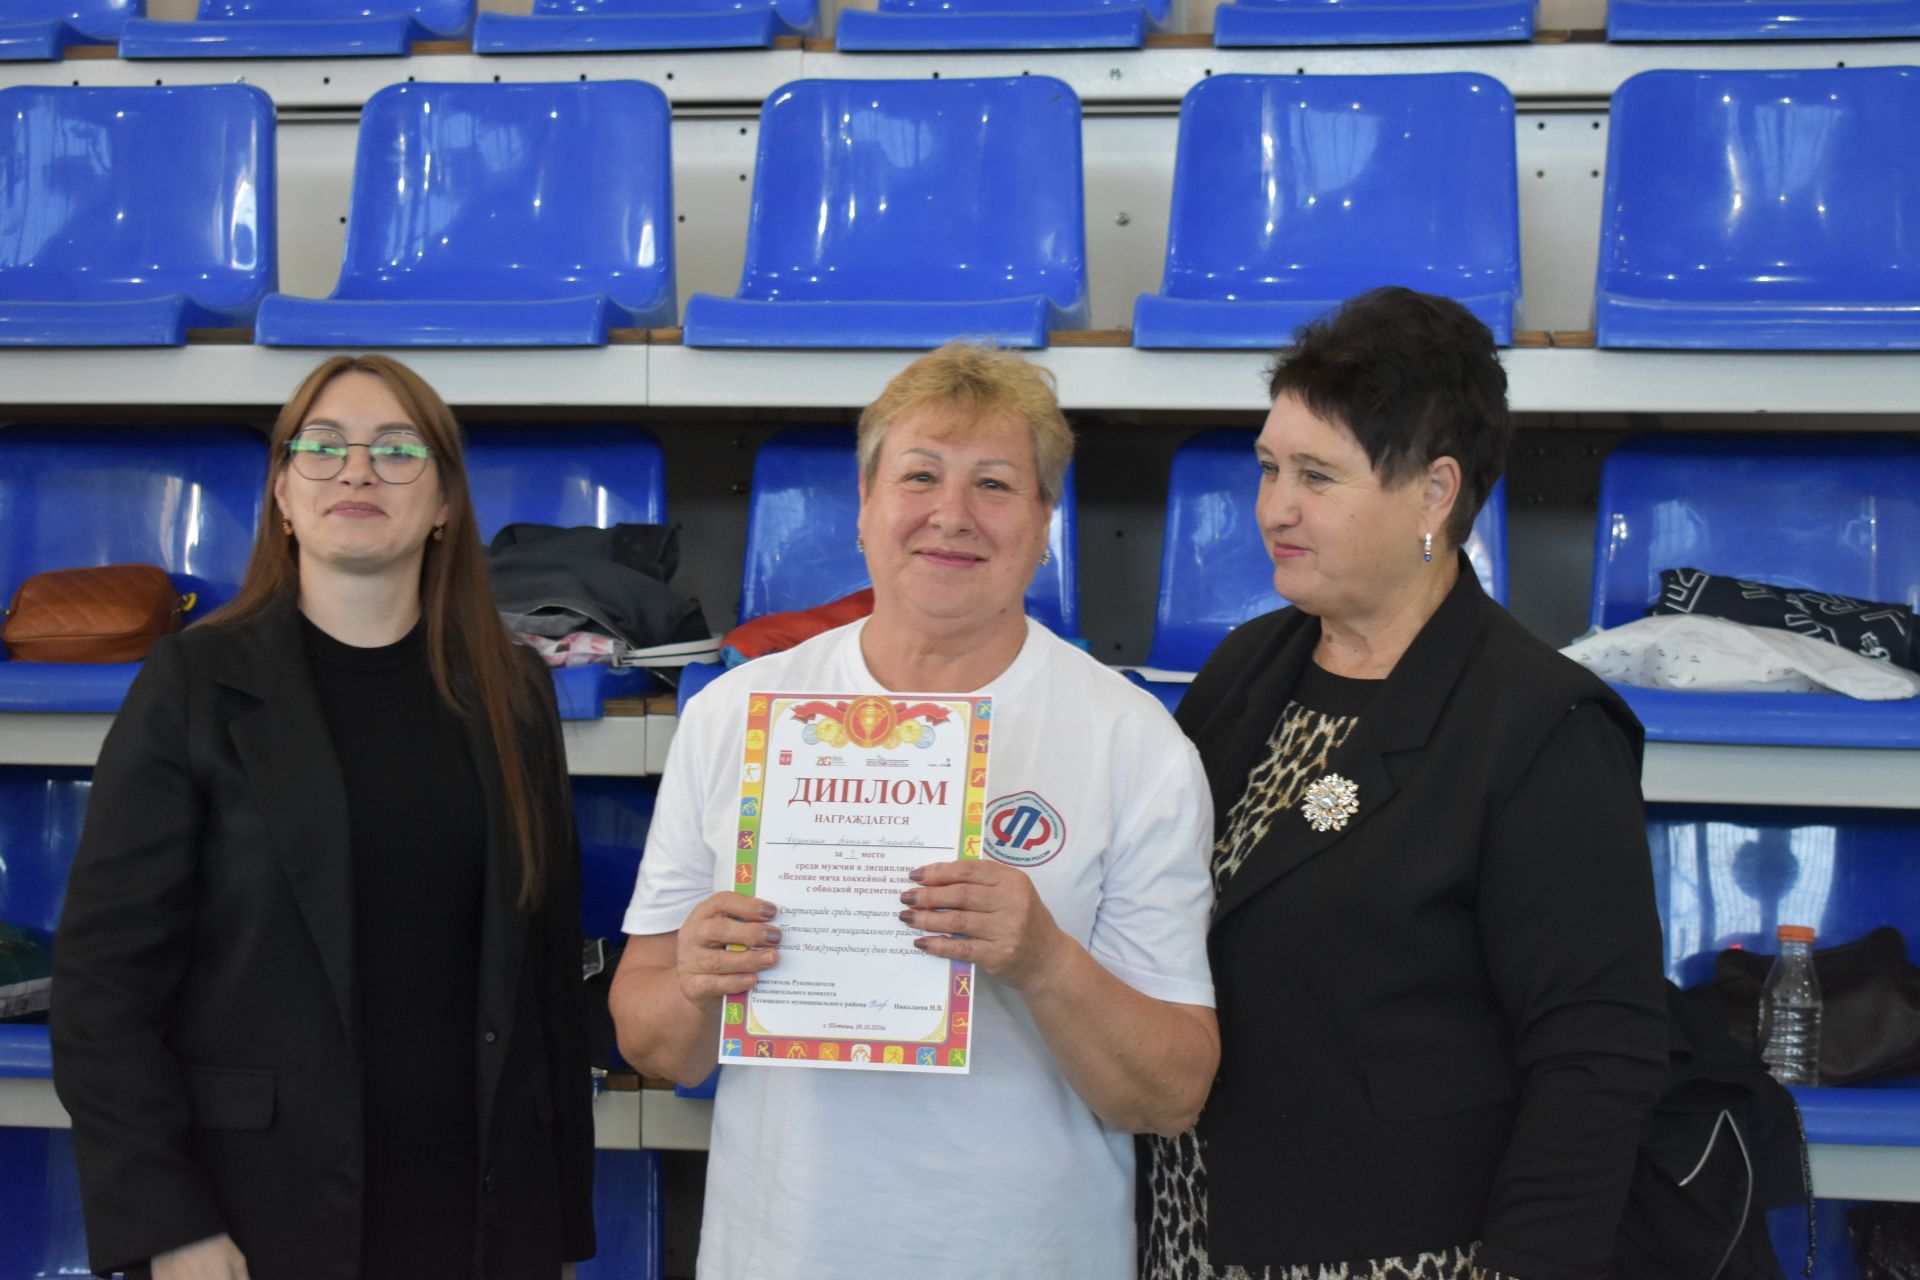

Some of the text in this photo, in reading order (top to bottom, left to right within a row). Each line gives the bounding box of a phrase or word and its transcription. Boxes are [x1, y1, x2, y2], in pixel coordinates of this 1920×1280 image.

[788, 777, 951, 808] ДИПЛОМ
[815, 814, 910, 826] НАГРАЖДАЕТСЯ
[834, 850, 843, 858] за
[861, 851, 886, 859] место
[795, 863, 820, 873] среди
[821, 863, 855, 873] мужчин
[819, 874, 840, 883] мяча
[842, 873, 887, 884] хоккейной
[812, 884, 852, 894] обводкой
[831, 907, 853, 918] среди
[871, 945, 888, 954] дню
